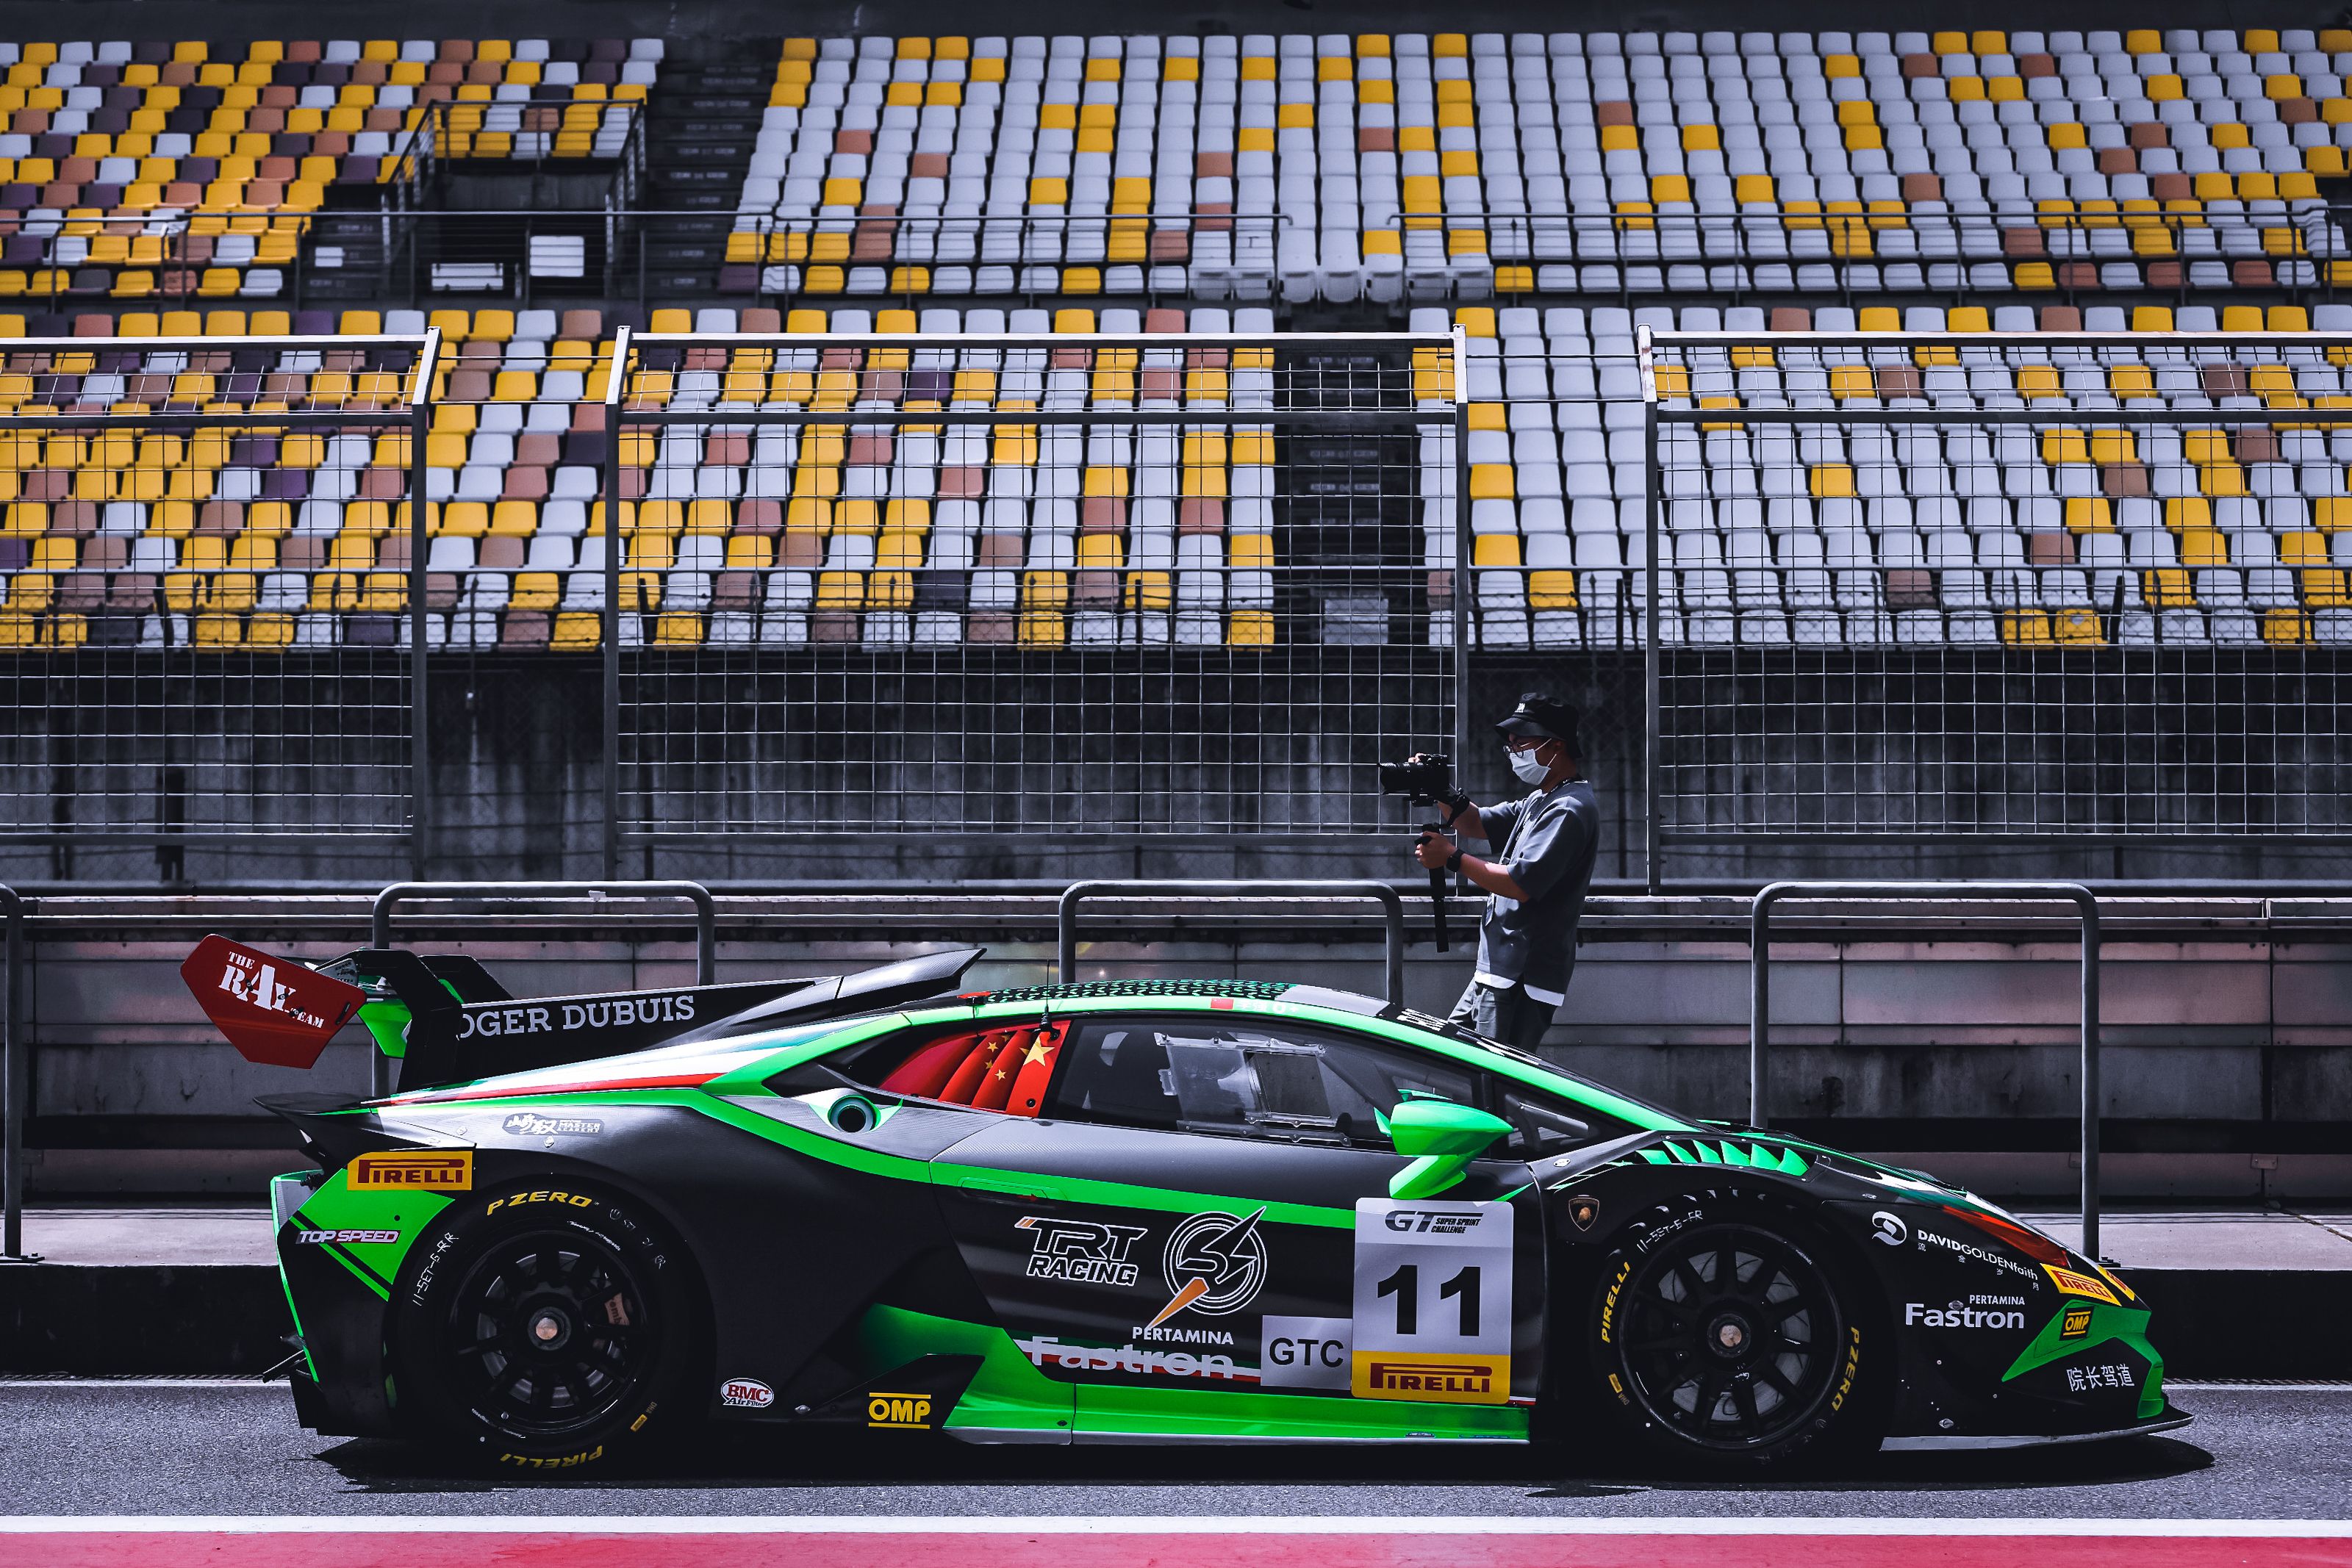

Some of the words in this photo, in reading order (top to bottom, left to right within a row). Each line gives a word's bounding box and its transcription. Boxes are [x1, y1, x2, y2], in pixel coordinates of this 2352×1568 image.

[229, 951, 256, 969] THE
[218, 964, 296, 1012] RAY
[460, 1007, 551, 1038] OGER
[562, 995, 695, 1030] DUBUIS
[357, 1159, 465, 1184] PIRELLI
[1431, 1225, 1466, 1234] CHALLENGE
[1435, 1217, 1456, 1226] SUPER
[1456, 1218, 1481, 1226] SPRINT
[299, 1230, 337, 1242] TOP
[336, 1230, 400, 1242] SPEED
[1014, 1216, 1148, 1262] TRT
[1026, 1254, 1139, 1286] RACING
[2051, 1270, 2112, 1299] PIRELLI
[1377, 1265, 1481, 1337] 11
[1602, 1262, 1630, 1344] PIRELLI
[1970, 1294, 2025, 1306] PERTAMINA
[1905, 1303, 2024, 1329] Fastron
[2065, 1315, 2090, 1331] OMP
[1132, 1326, 1233, 1345] PERTAMINA
[1031, 1336, 1233, 1379] Fastron
[1269, 1337, 1344, 1367] GTC
[1370, 1362, 1493, 1393] PIRELLI
[2066, 1363, 2134, 1392] 院长驾道
[726, 1384, 770, 1403] BMC
[868, 1398, 931, 1423] OMP
[500, 1445, 603, 1469] PIRELLI
